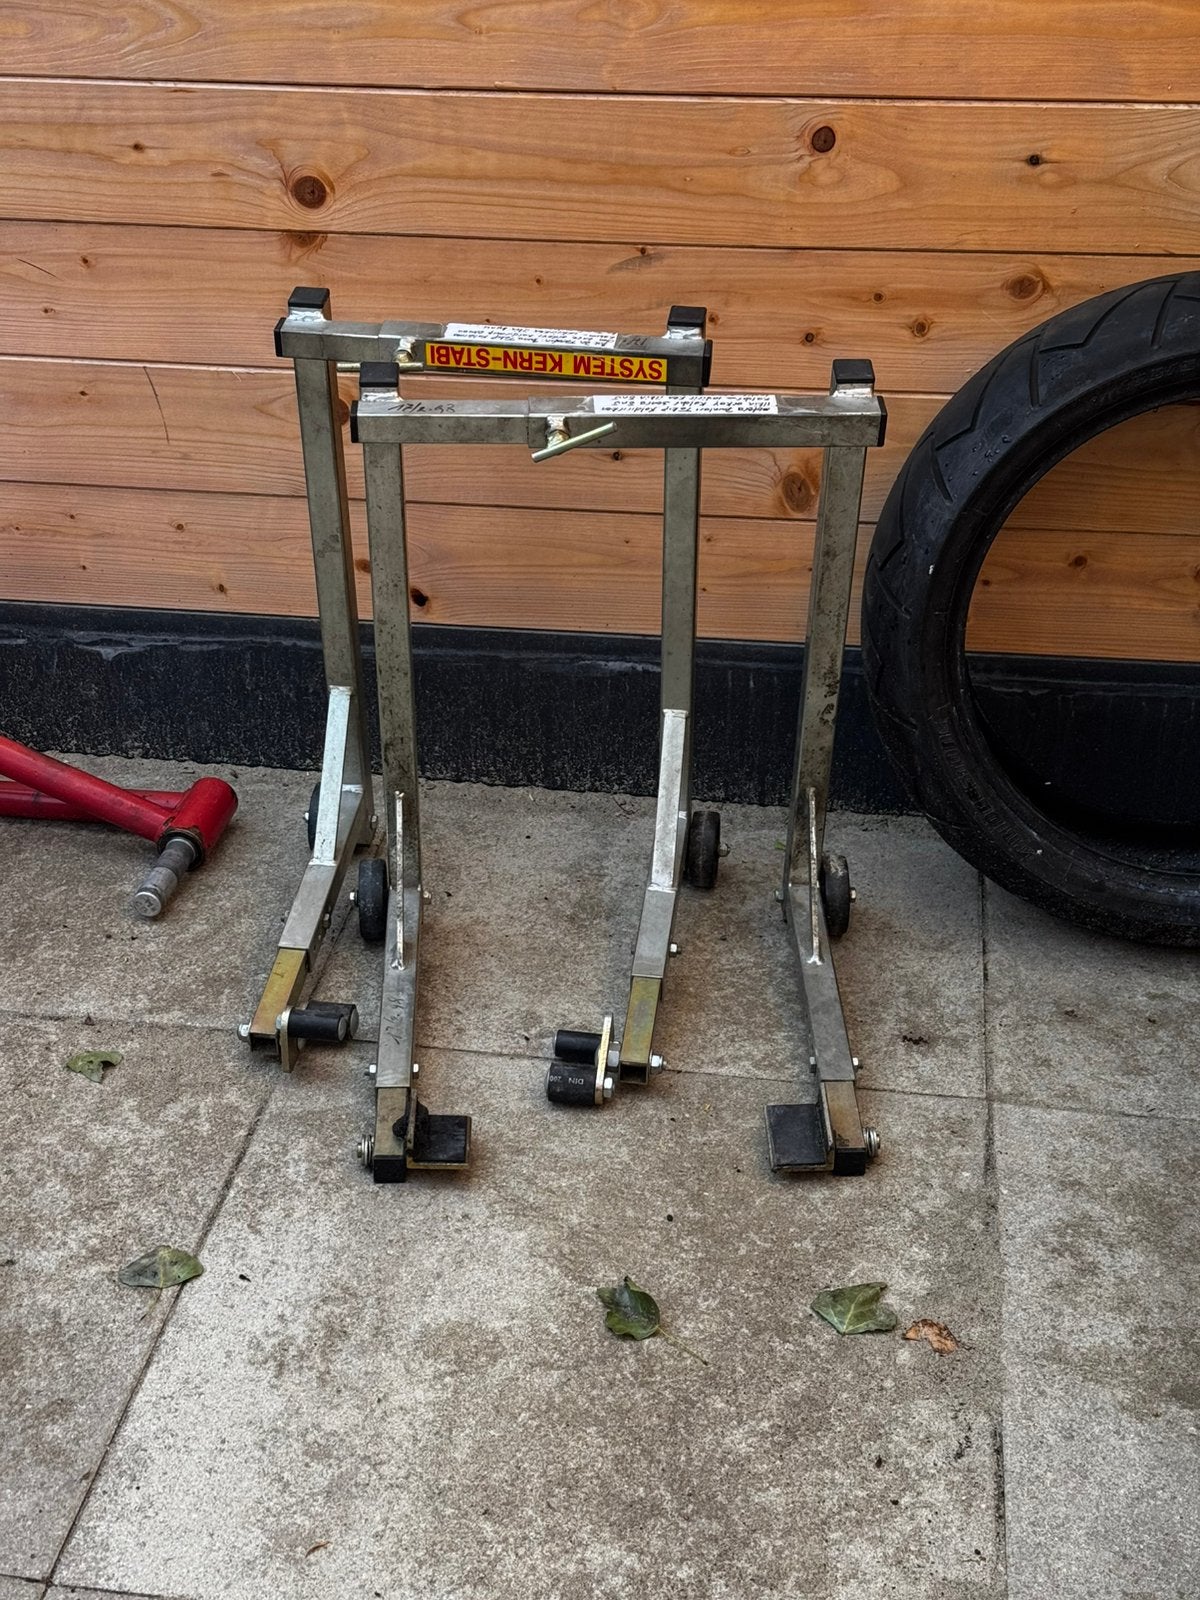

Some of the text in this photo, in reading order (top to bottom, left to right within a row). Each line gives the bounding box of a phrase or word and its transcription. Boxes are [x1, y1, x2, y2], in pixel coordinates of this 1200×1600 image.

[430, 344, 663, 381] SYSTEM KERN-STABI
[568, 1077, 584, 1085] DIN
